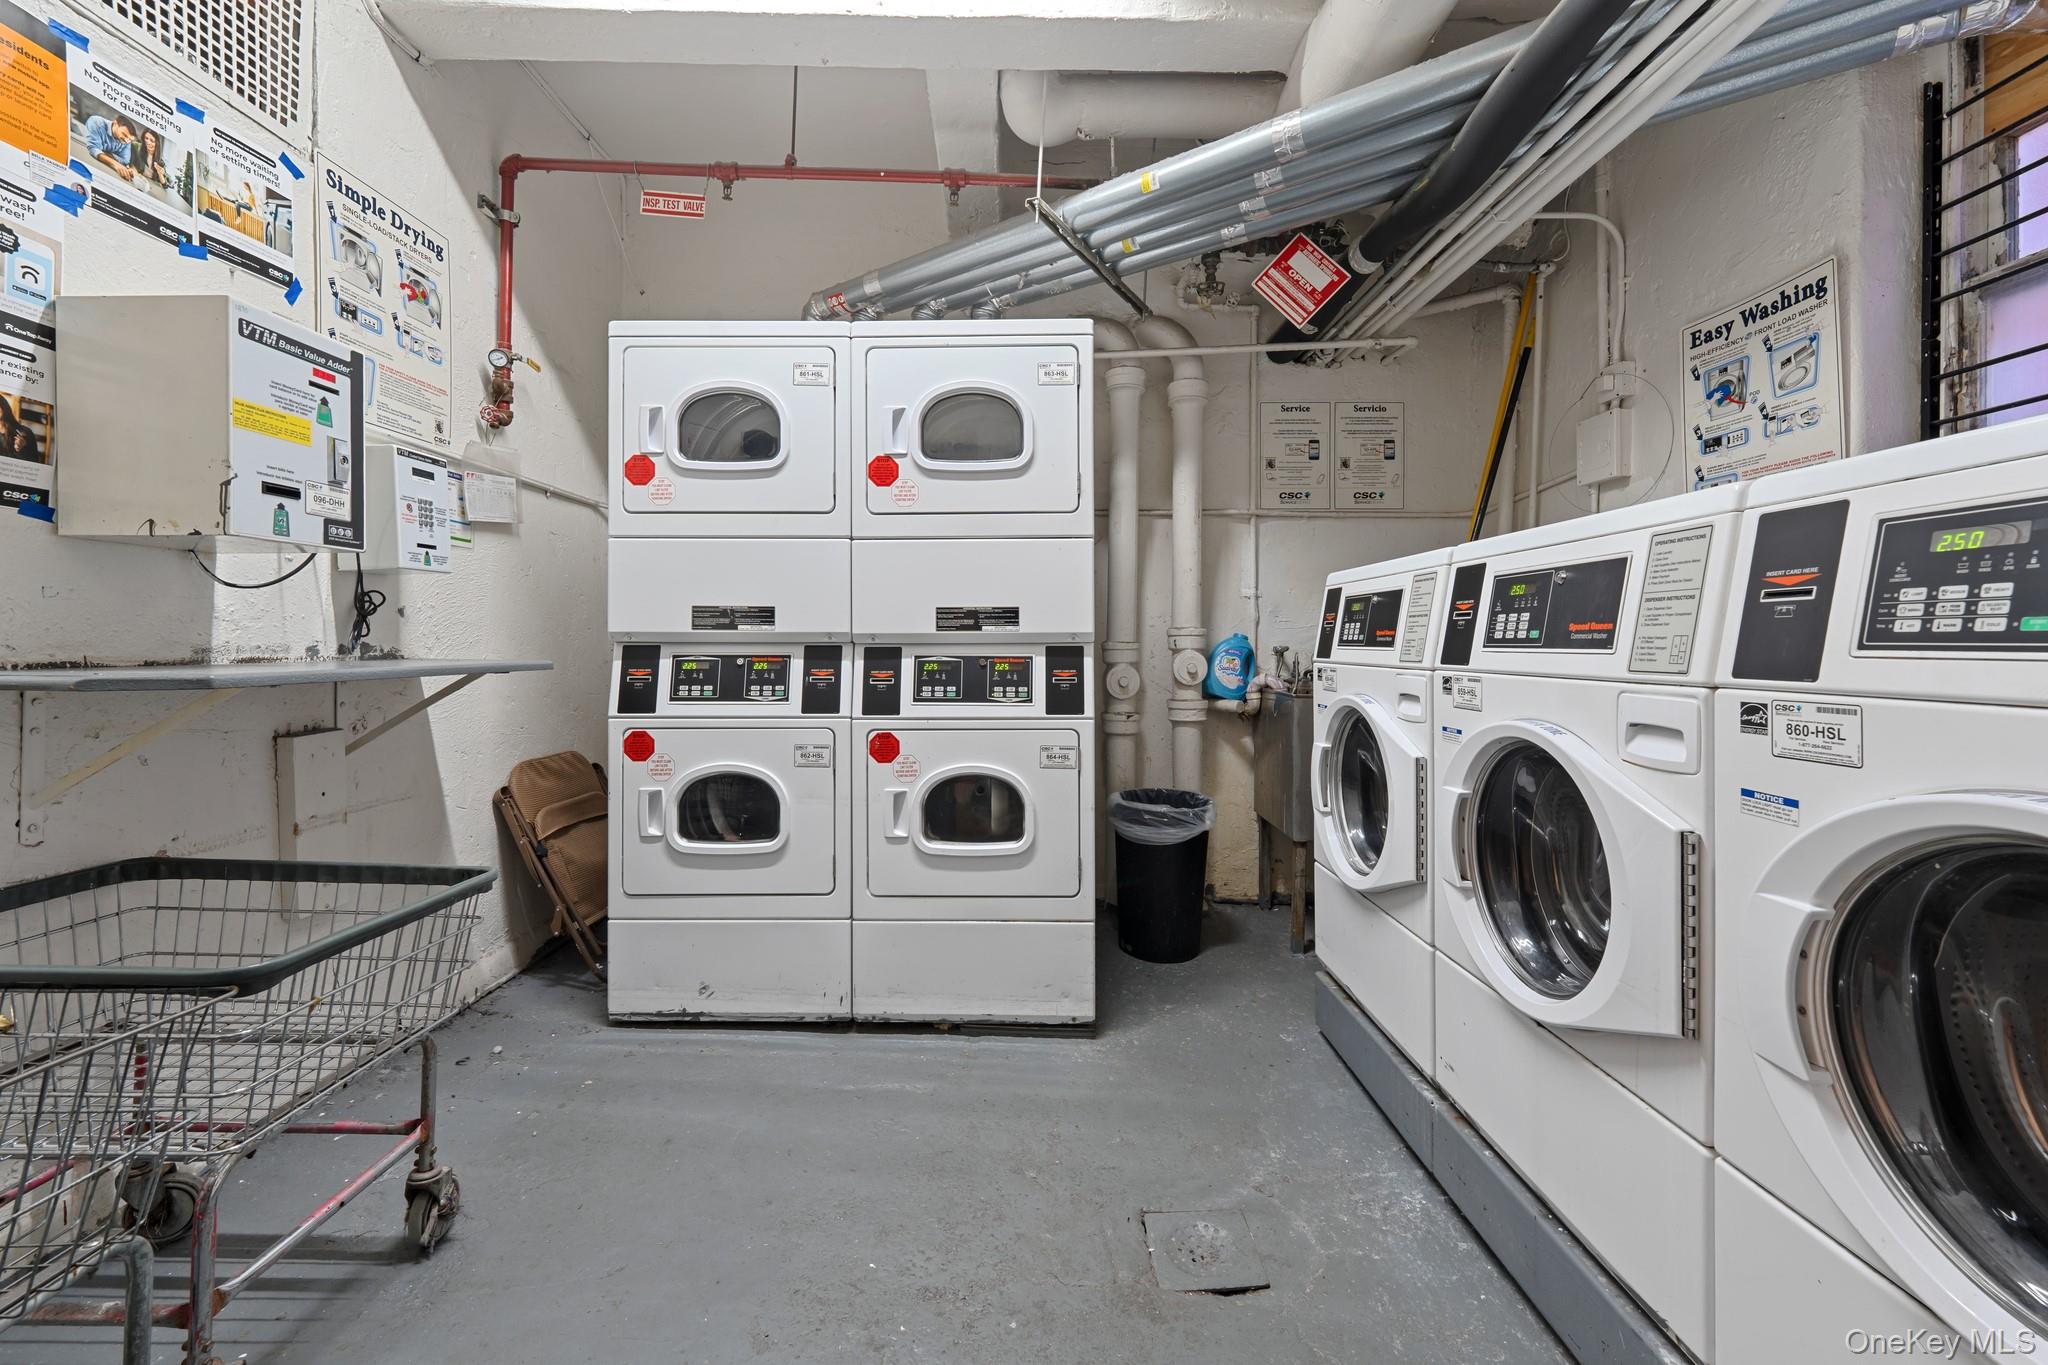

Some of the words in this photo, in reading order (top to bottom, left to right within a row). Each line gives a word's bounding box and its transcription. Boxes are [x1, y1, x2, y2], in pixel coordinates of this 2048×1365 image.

[84, 68, 100, 83] No
[103, 81, 132, 102] more
[134, 98, 182, 134] searching
[102, 89, 118, 103] for
[120, 101, 168, 132] quarters!
[211, 136, 223, 148] No
[226, 145, 248, 162] more
[250, 158, 279, 181] waiting
[210, 146, 219, 154] or
[221, 152, 252, 174] setting
[253, 168, 281, 188] timers!
[0, 194, 36, 216] wash
[642, 198, 660, 209] INSP.
[662, 199, 680, 210] TEST
[683, 201, 704, 212] VALVE
[326, 168, 387, 222] Simple
[390, 208, 444, 262] Drying
[160, 226, 179, 240] CSC
[409, 245, 433, 264] DRYERS
[268, 268, 284, 279] CSC
[1287, 268, 1313, 292] OPEN
[1690, 319, 1735, 350] Easy
[1740, 275, 1828, 328] Washing
[1690, 336, 1744, 362] HIGH-EFFICIENCY
[1754, 324, 1776, 336] FRONT
[1778, 313, 1797, 326] LOAD
[1798, 298, 1828, 318] WASHER
[241, 320, 278, 348] VTM
[278, 340, 303, 355] Basic
[304, 349, 326, 364] Value
[327, 359, 352, 374] Adder
[8, 361, 44, 378] existing
[25, 374, 39, 385] by:
[1280, 404, 1310, 412] Service
[1354, 404, 1387, 412] Servicio
[434, 436, 447, 445] CSC
[3, 490, 29, 500] CSC
[313, 494, 345, 508] 096-DHH
[1654, 537, 1677, 546] OPERATING
[1677, 534, 1707, 542] INSTRUCTIONS
[1766, 569, 1785, 578] INSERT
[1786, 568, 1802, 576] CARD
[1568, 622, 1590, 632] Speed
[1591, 622, 1614, 630] Queen
[1786, 723, 1846, 741] 860-HSL
[1754, 791, 1784, 804] NOTICE
